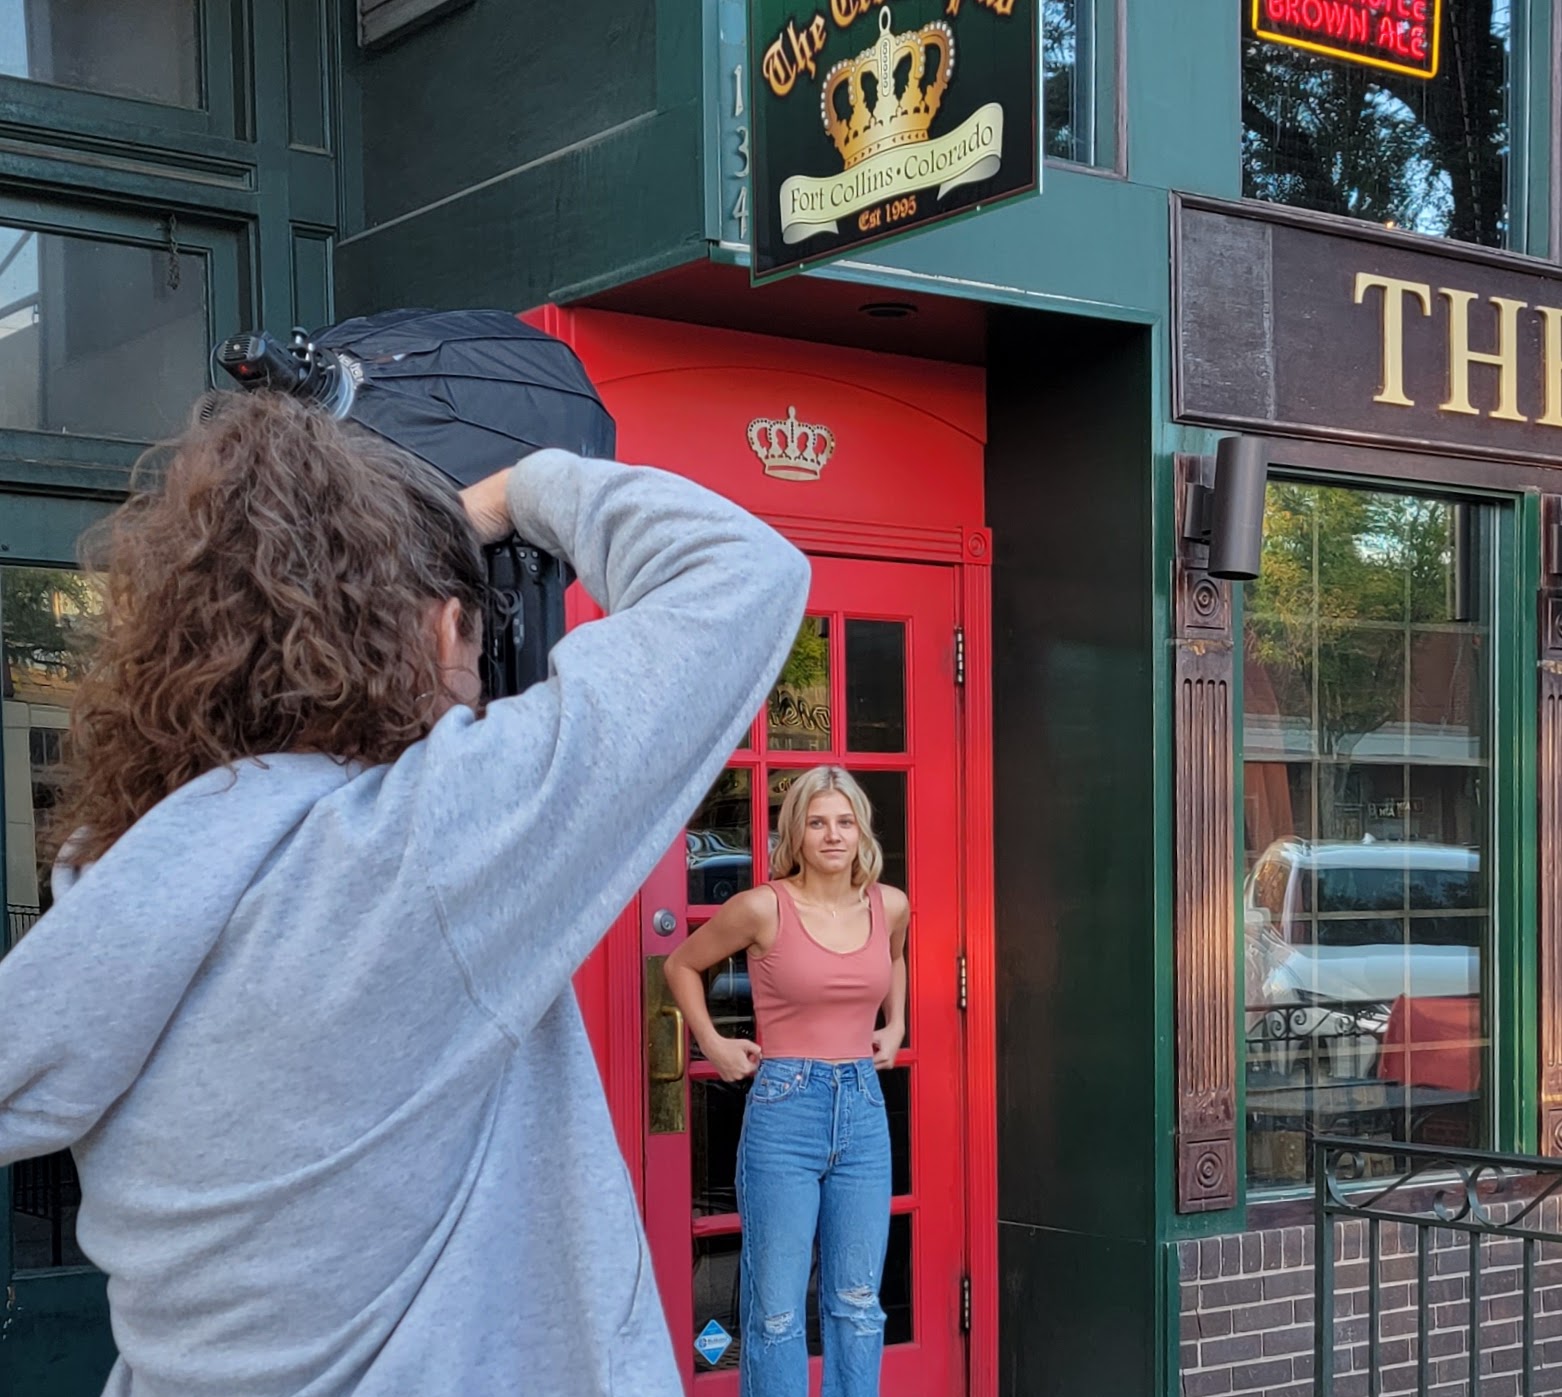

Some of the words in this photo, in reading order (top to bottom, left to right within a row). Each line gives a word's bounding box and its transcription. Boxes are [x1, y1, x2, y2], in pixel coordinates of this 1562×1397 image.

[762, 14, 827, 96] The
[1266, 0, 1370, 42] BROWN
[1378, 16, 1426, 60] ALE
[791, 187, 824, 215] Fort
[830, 166, 894, 207] Collins
[904, 122, 994, 180] Colorado
[858, 208, 881, 231] Est
[886, 195, 917, 222] 1995
